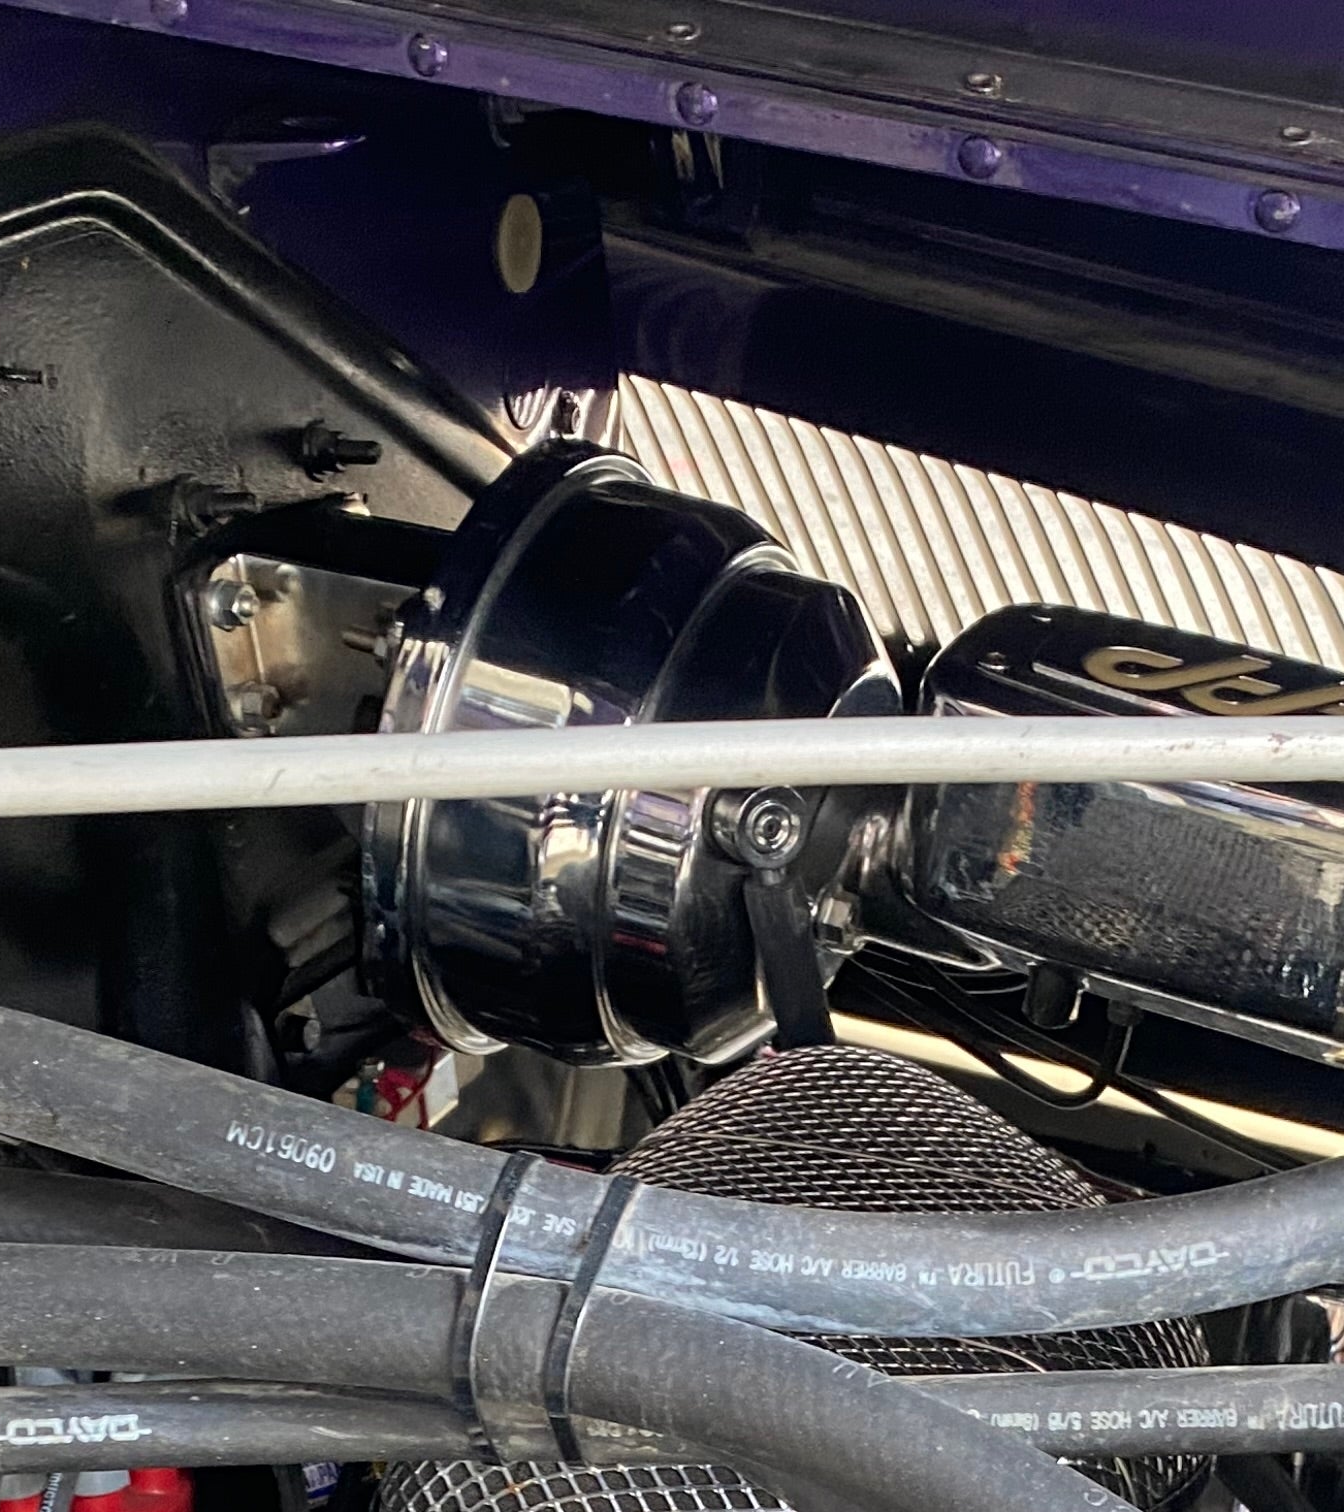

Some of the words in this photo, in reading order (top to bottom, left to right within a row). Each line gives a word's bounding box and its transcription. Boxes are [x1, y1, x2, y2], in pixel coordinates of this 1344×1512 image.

[225, 1119, 336, 1173] 09061CM
[353, 1161, 385, 1185] USA
[387, 1169, 406, 1190] IN
[408, 1174, 453, 1203] MADE
[542, 1213, 577, 1237] SAE
[748, 1248, 794, 1275] HOSE
[840, 1259, 907, 1281] BARRIER
[946, 1259, 1037, 1286] FUTURA
[1069, 1240, 1230, 1281] DAYCO
[1090, 1410, 1132, 1431] HOSE
[1139, 1409, 1169, 1429] A/C
[1177, 1408, 1237, 1429] BARRIER
